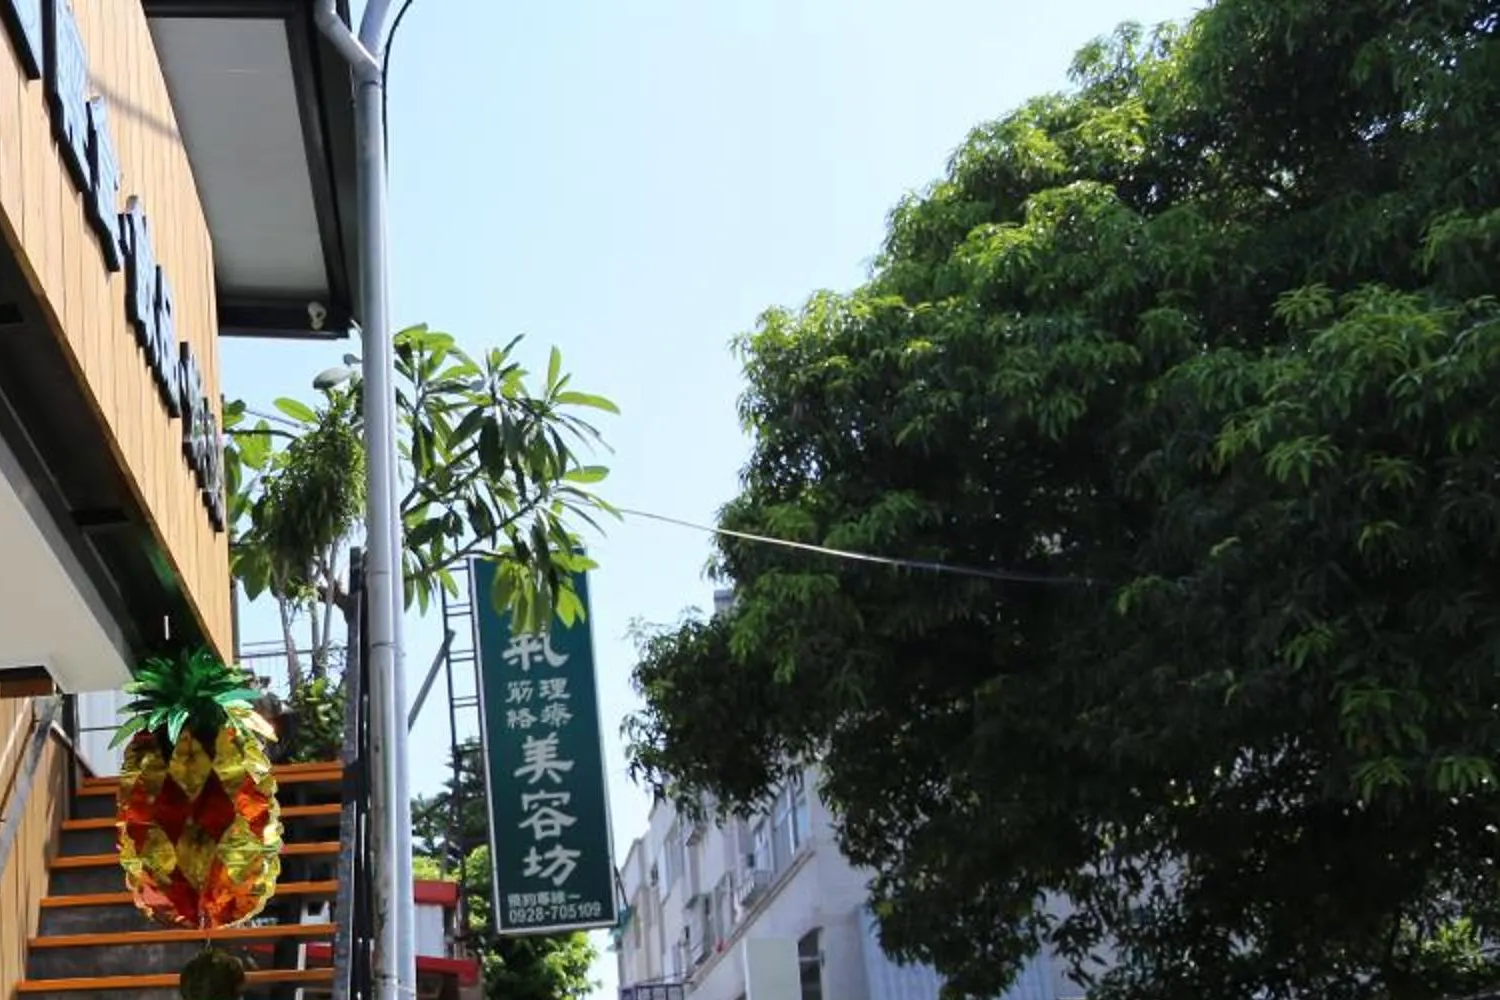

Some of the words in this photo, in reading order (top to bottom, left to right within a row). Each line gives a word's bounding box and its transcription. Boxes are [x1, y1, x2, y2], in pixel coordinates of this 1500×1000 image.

[513, 731, 582, 888] 美容坊
[508, 901, 602, 924] 0928-705109
